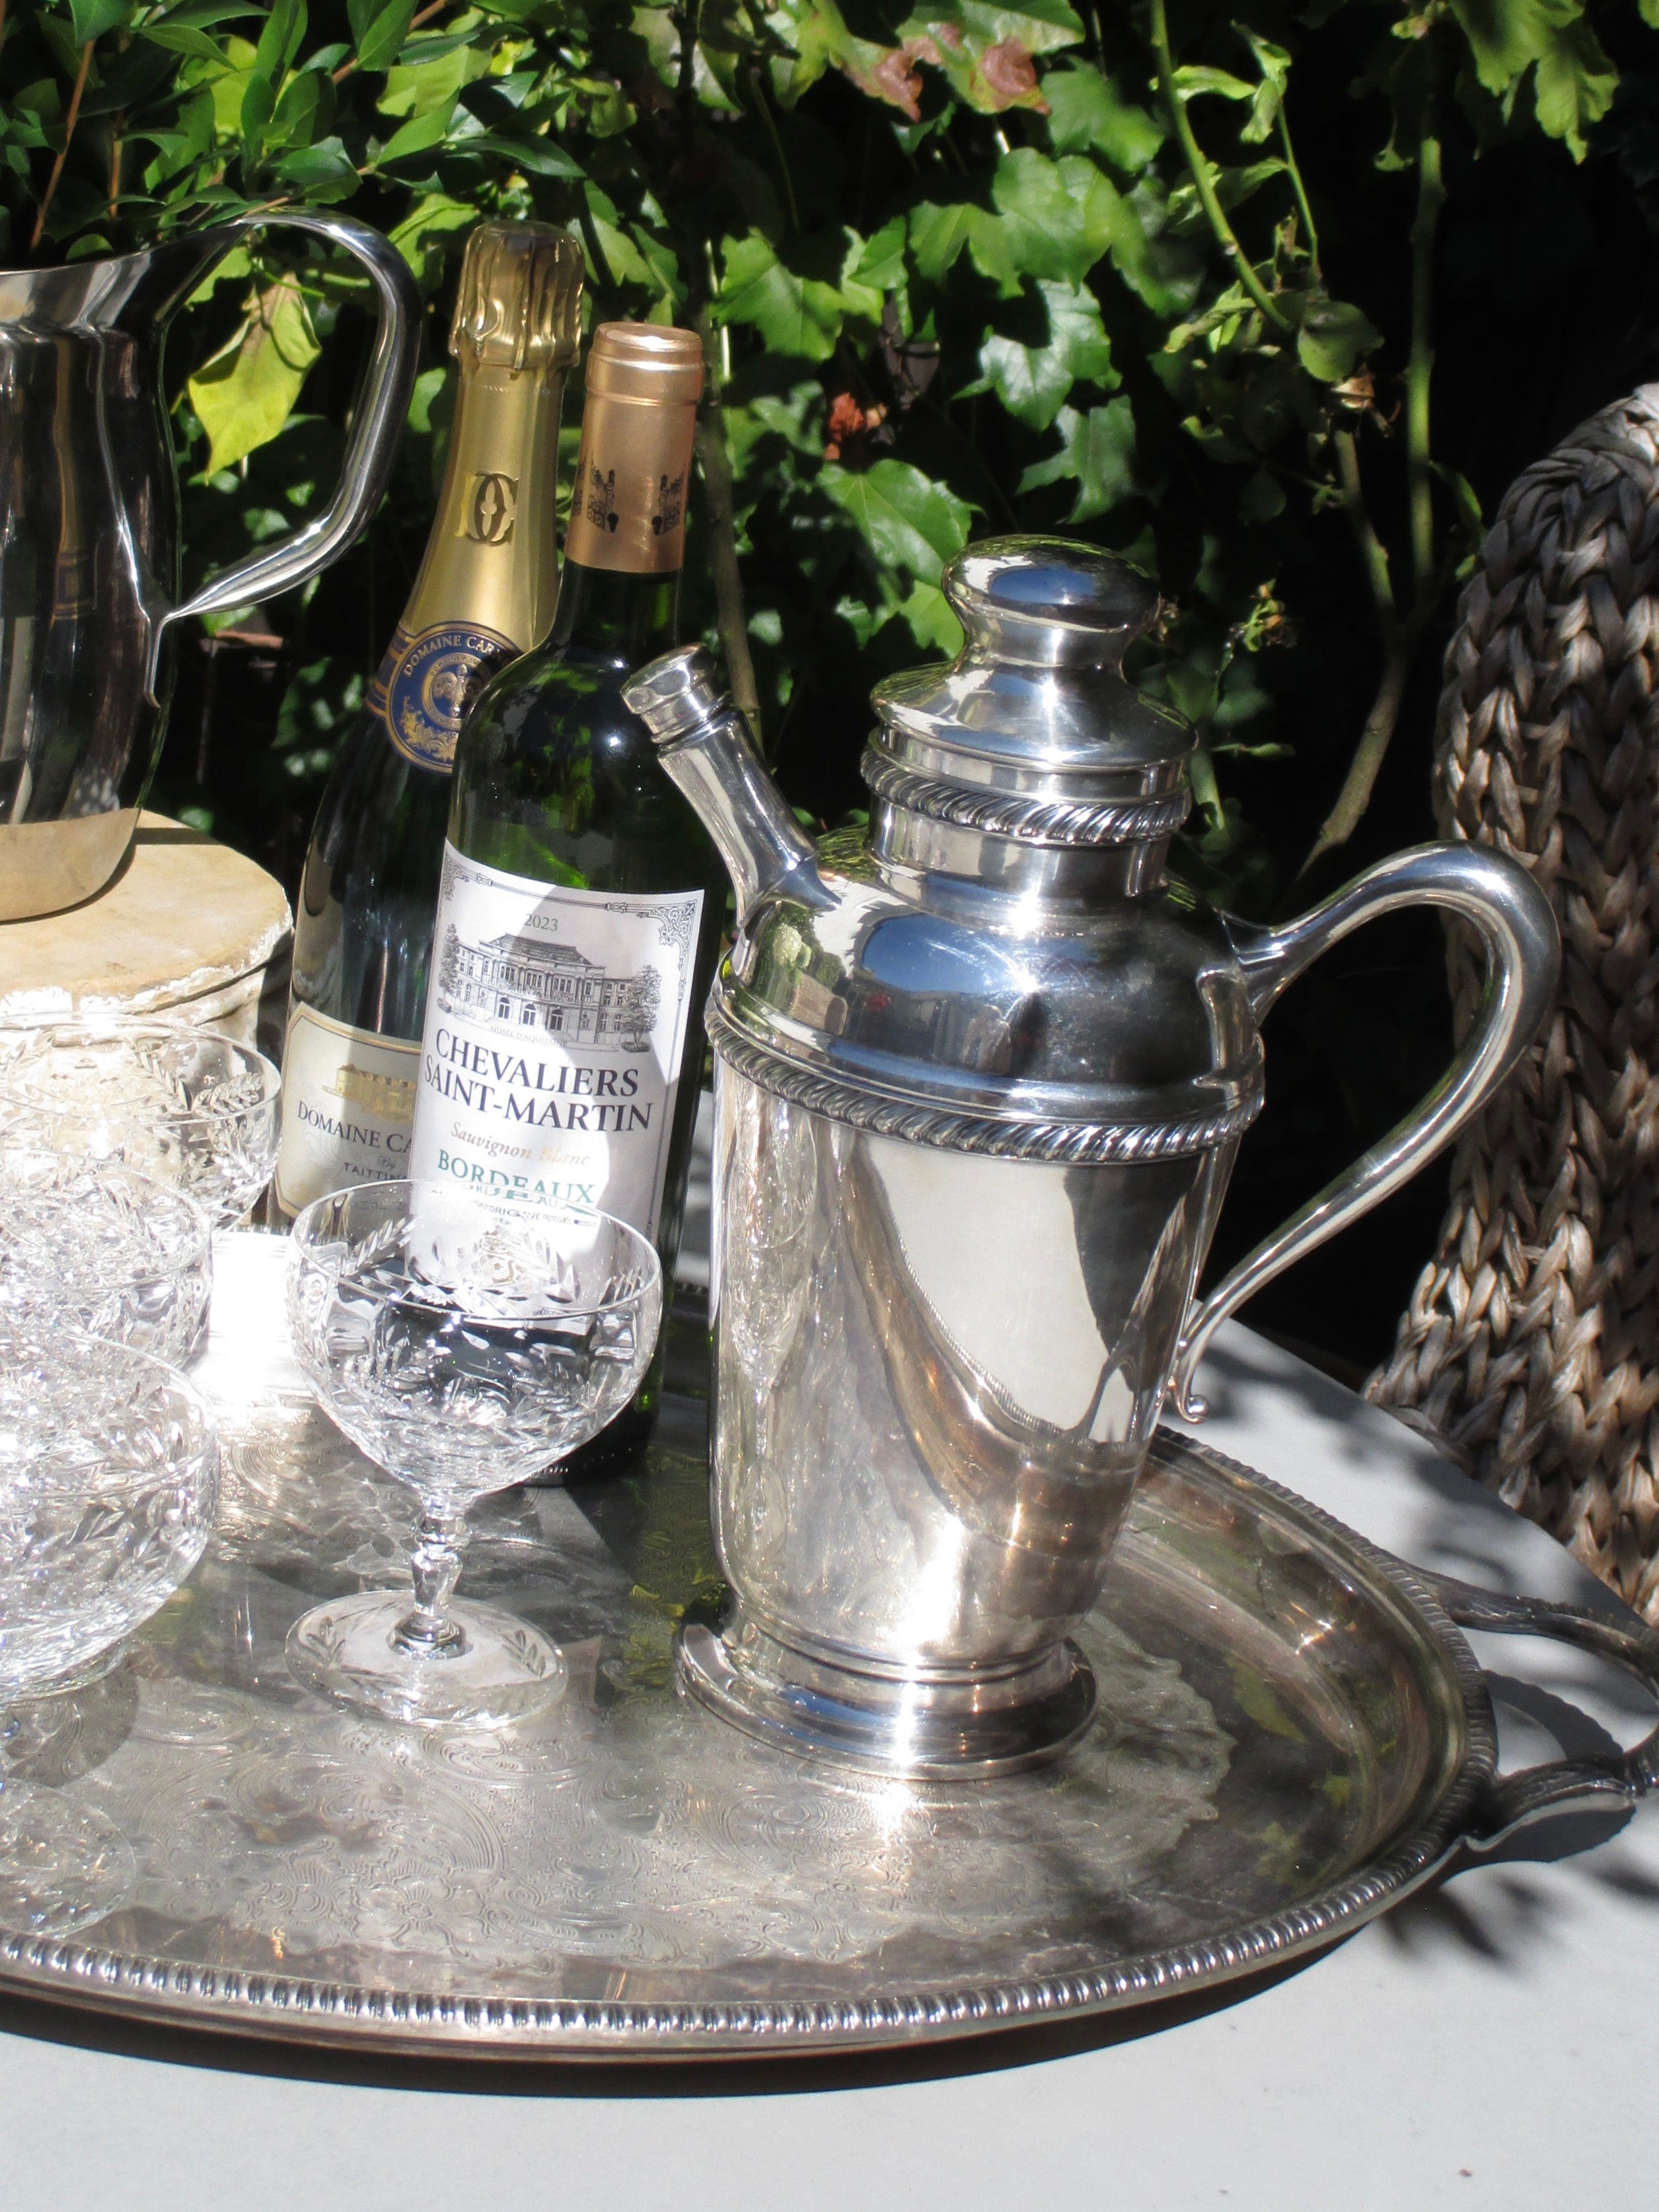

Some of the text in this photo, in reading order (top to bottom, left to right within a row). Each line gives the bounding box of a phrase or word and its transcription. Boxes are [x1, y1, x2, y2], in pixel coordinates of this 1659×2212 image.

[403, 634, 461, 677] DOMAINE
[524, 913, 558, 932] 2023
[435, 1028, 639, 1097] CHEVALIERS
[424, 1054, 654, 1132] SAINT-MARTIN
[297, 1100, 381, 1148] DOMAINE
[451, 1121, 591, 1166] Sauvignon Blanc
[437, 1148, 596, 1204] BORDEAUX
